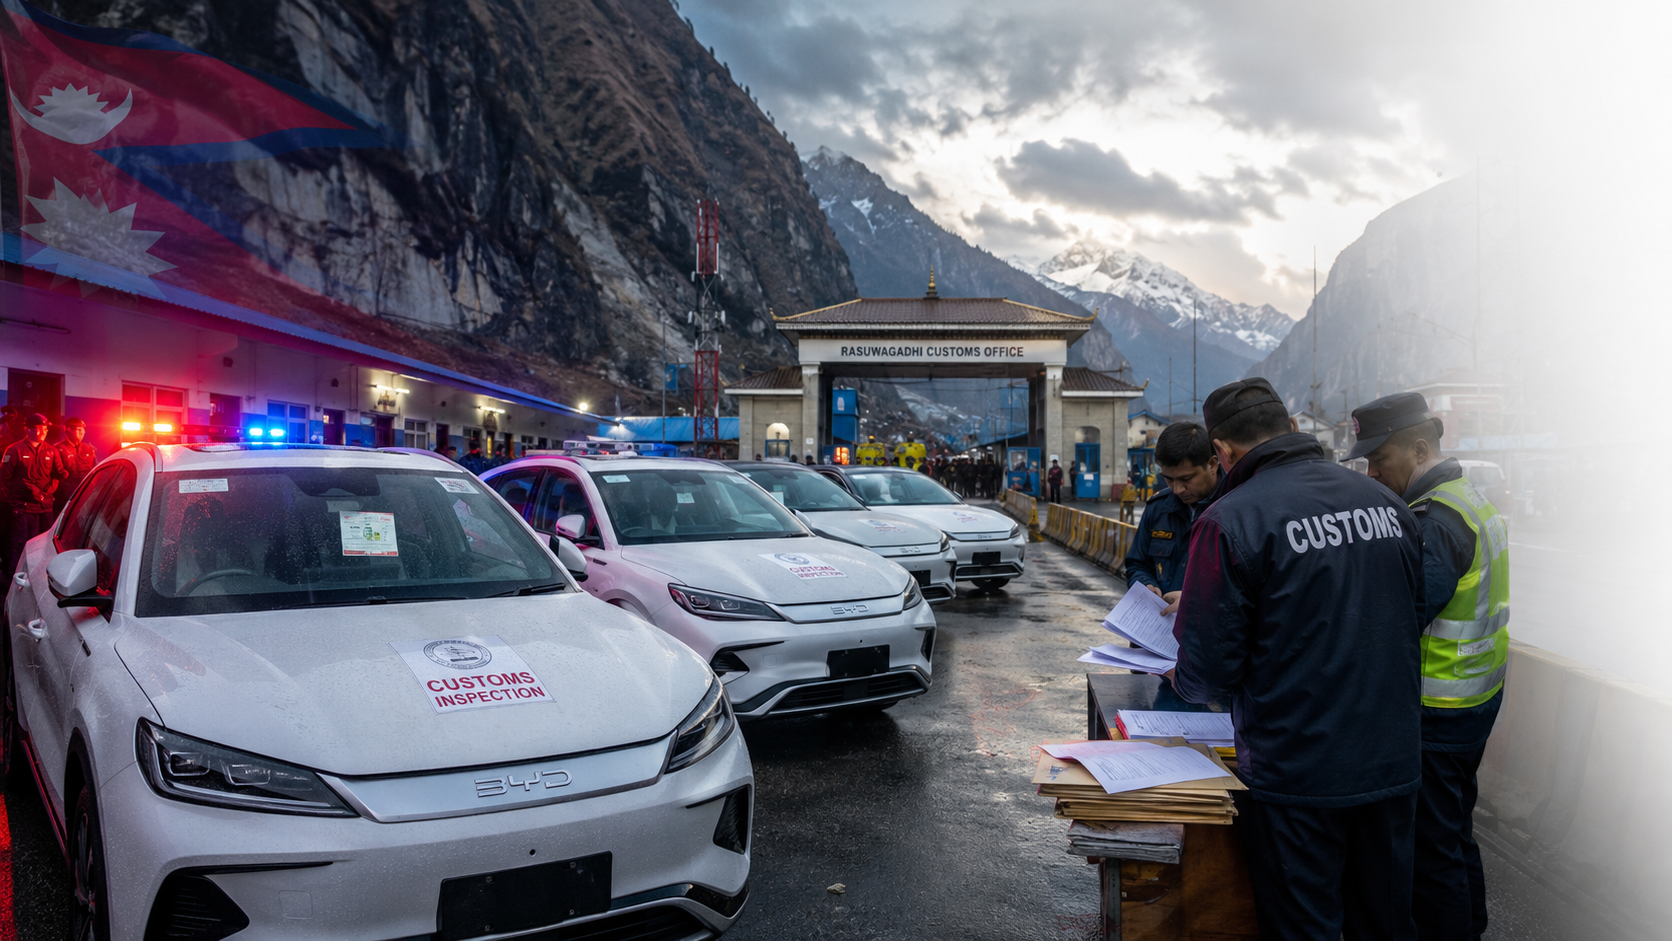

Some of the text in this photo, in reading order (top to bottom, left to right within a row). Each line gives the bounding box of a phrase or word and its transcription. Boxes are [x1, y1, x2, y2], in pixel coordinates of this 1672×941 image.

[841, 346, 1024, 357] RASUWAGADHI CUSTOMS OFFICE
[1286, 506, 1403, 553] CUSTOMS
[426, 671, 536, 693] CUSTOMS
[434, 686, 546, 708] INSPECTION
[474, 769, 573, 798] BYD
